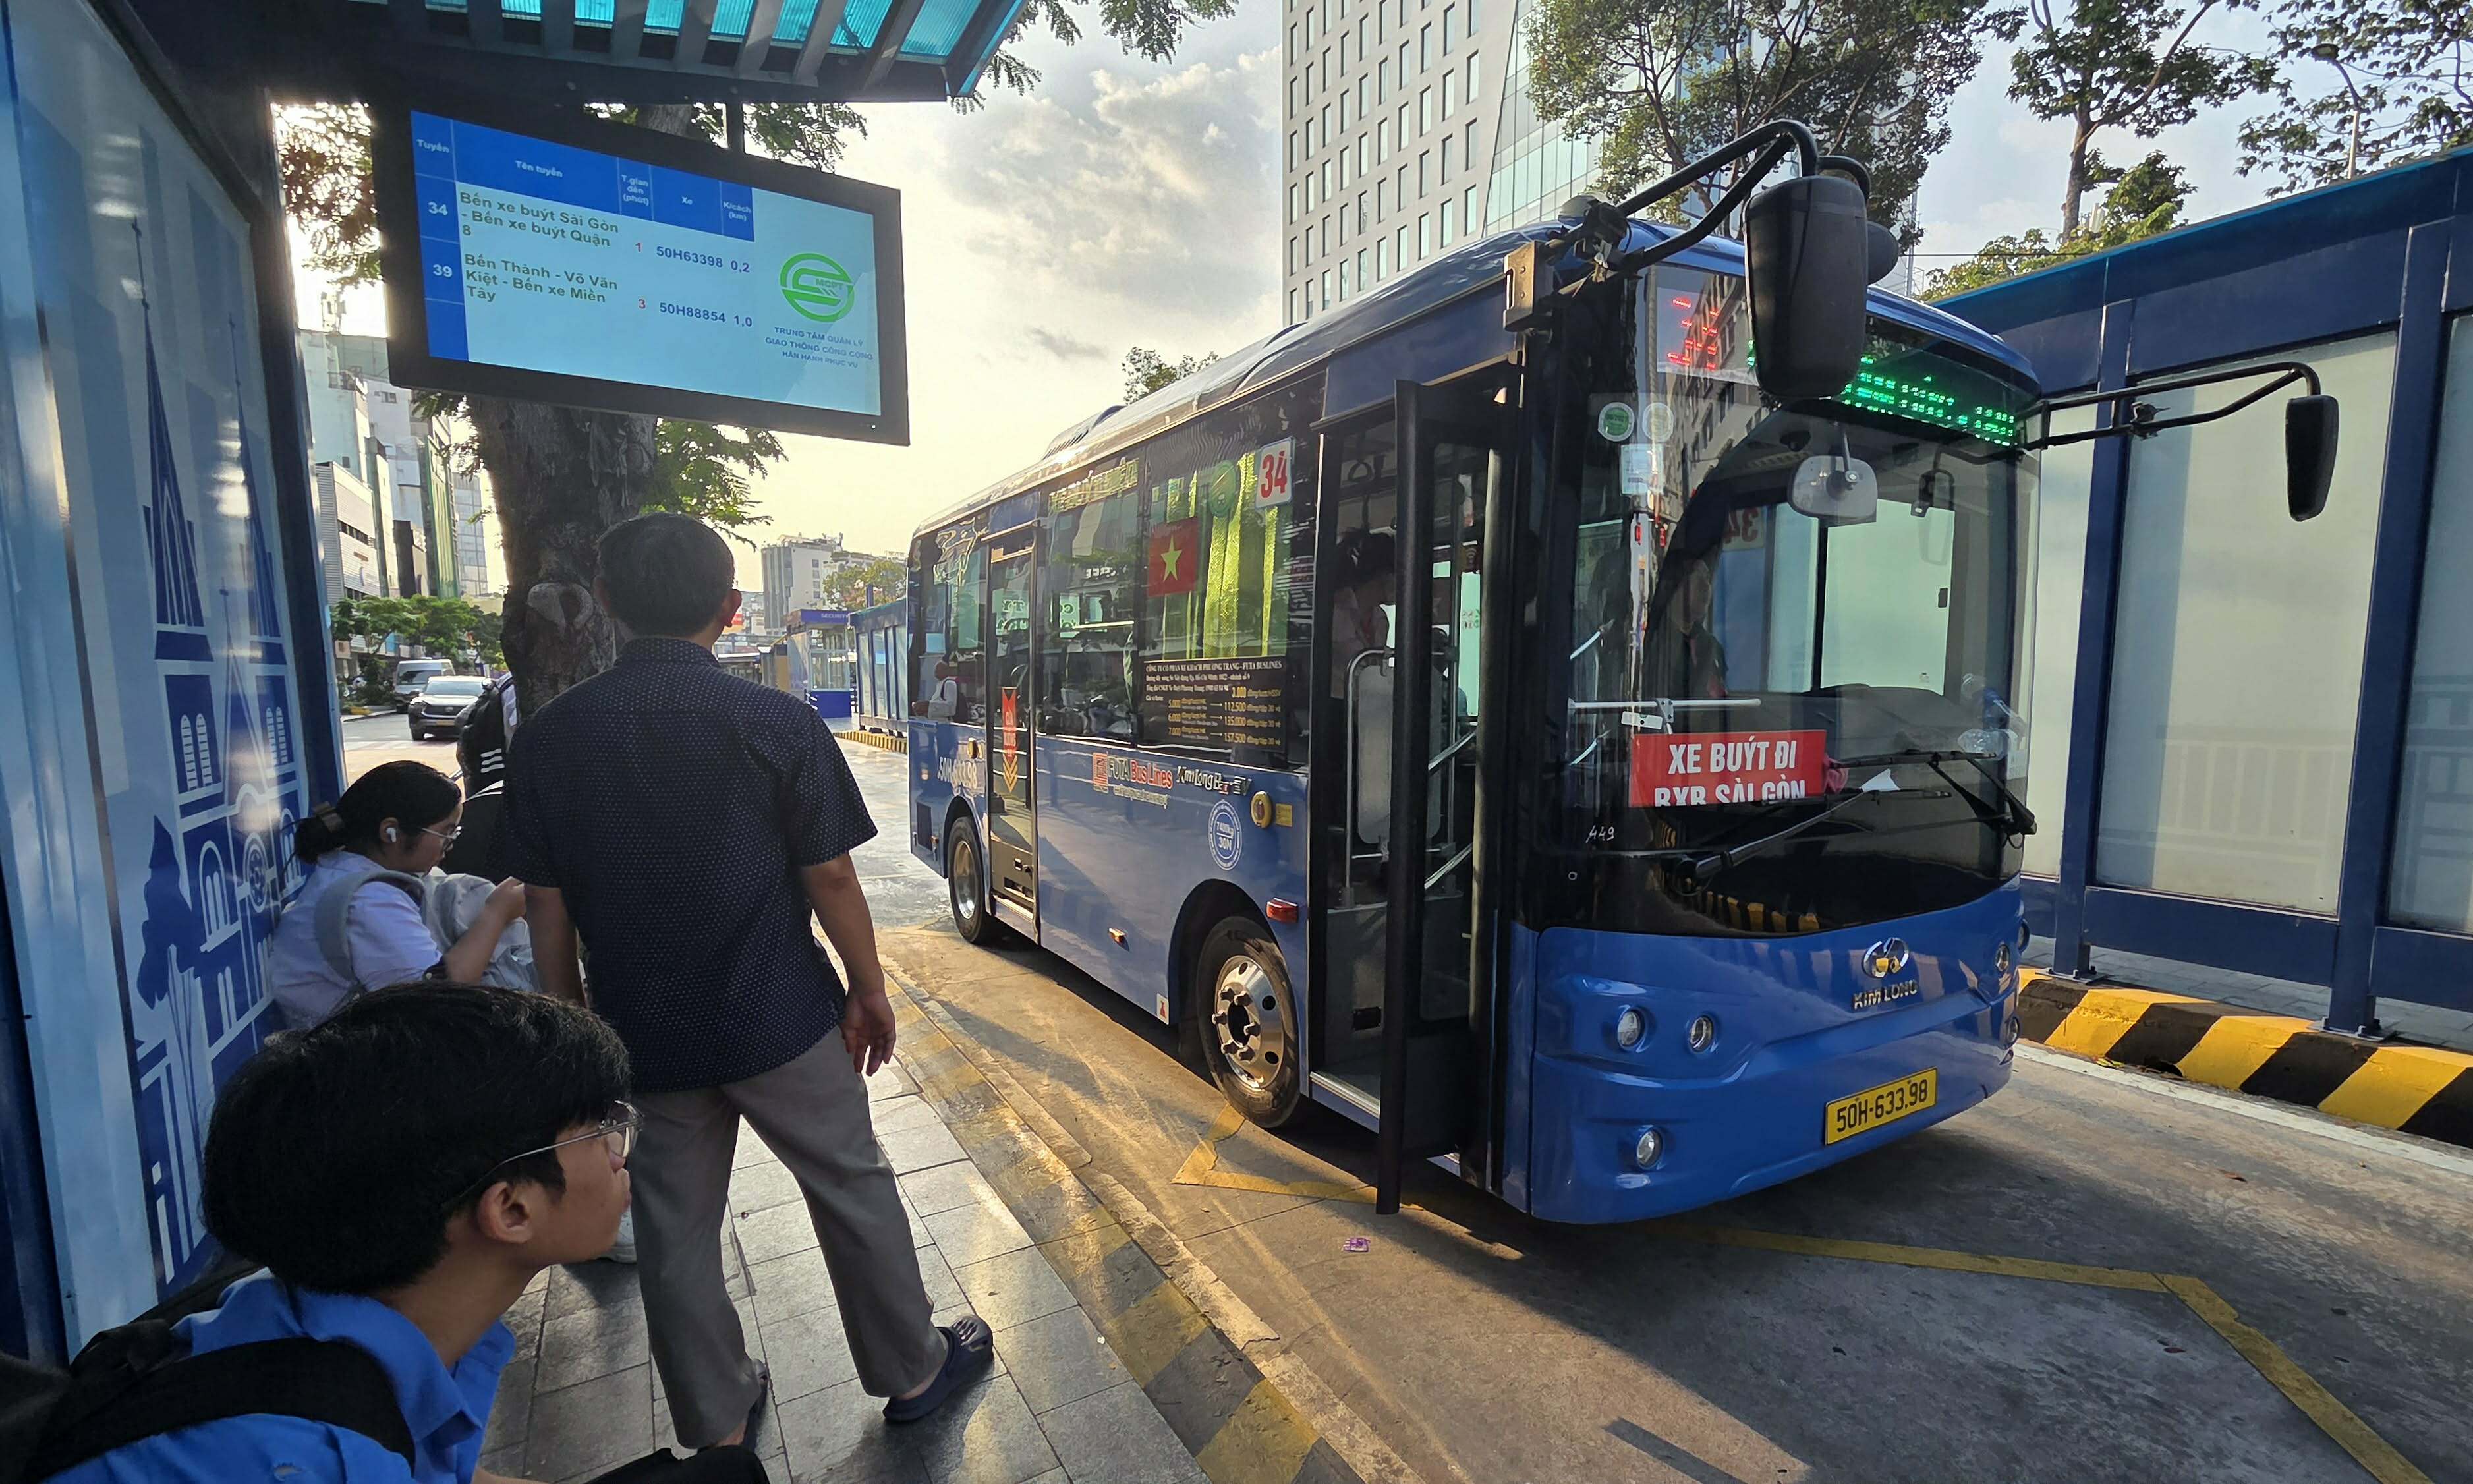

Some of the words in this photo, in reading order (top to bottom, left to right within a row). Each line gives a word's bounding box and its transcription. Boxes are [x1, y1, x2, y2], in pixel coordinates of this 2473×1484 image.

[416, 138, 449, 154] Tuyến
[515, 160, 534, 171] Tên
[536, 165, 563, 178] tuyến
[428, 202, 448, 215] 34
[681, 196, 693, 205] Xe
[460, 192, 492, 208] Bến
[497, 202, 515, 212] xe
[521, 204, 555, 221] buýt
[559, 212, 583, 226] Sài
[588, 217, 619, 233] Gòn
[729, 212, 747, 221] (km)
[462, 225, 471, 236] 8
[472, 210, 503, 227] Bến
[509, 219, 526, 231] xe
[532, 222, 565, 239] buýt
[570, 230, 610, 246] Quận
[635, 243, 642, 252] 1
[656, 246, 723, 268] 50H63398
[433, 264, 453, 278] 39
[465, 254, 496, 269] Bến
[501, 260, 550, 278] Thành
[564, 271, 585, 285] Võ
[589, 275, 617, 290] Văn
[731, 260, 750, 273] 0,2
[466, 270, 497, 287] Kiệt
[513, 278, 543, 293] Bến
[548, 285, 565, 296] xe
[571, 287, 606, 303] Miền
[467, 285, 496, 302] Tây
[639, 299, 646, 309] 3
[660, 302, 726, 322] 50H88854
[734, 315, 752, 327] 1,0
[774, 326, 805, 337] TRUNG
[807, 331, 825, 340] TÂM
[765, 337, 787, 347] GIAO
[790, 340, 820, 352] THÔNG
[822, 345, 846, 356] CÔNG
[1261, 450, 1288, 499] 34
[1668, 743, 1702, 774] XE
[1710, 735, 1769, 772] BUÝT
[1775, 741, 1797, 769] ĐI
[1108, 756, 1129, 782] FUTA
[1715, 778, 1754, 804] SÀI
[1762, 774, 1805, 801] GÒN
[1854, 990, 1881, 1010] KIM
[1836, 1078, 1928, 1133] 50H-633.98
